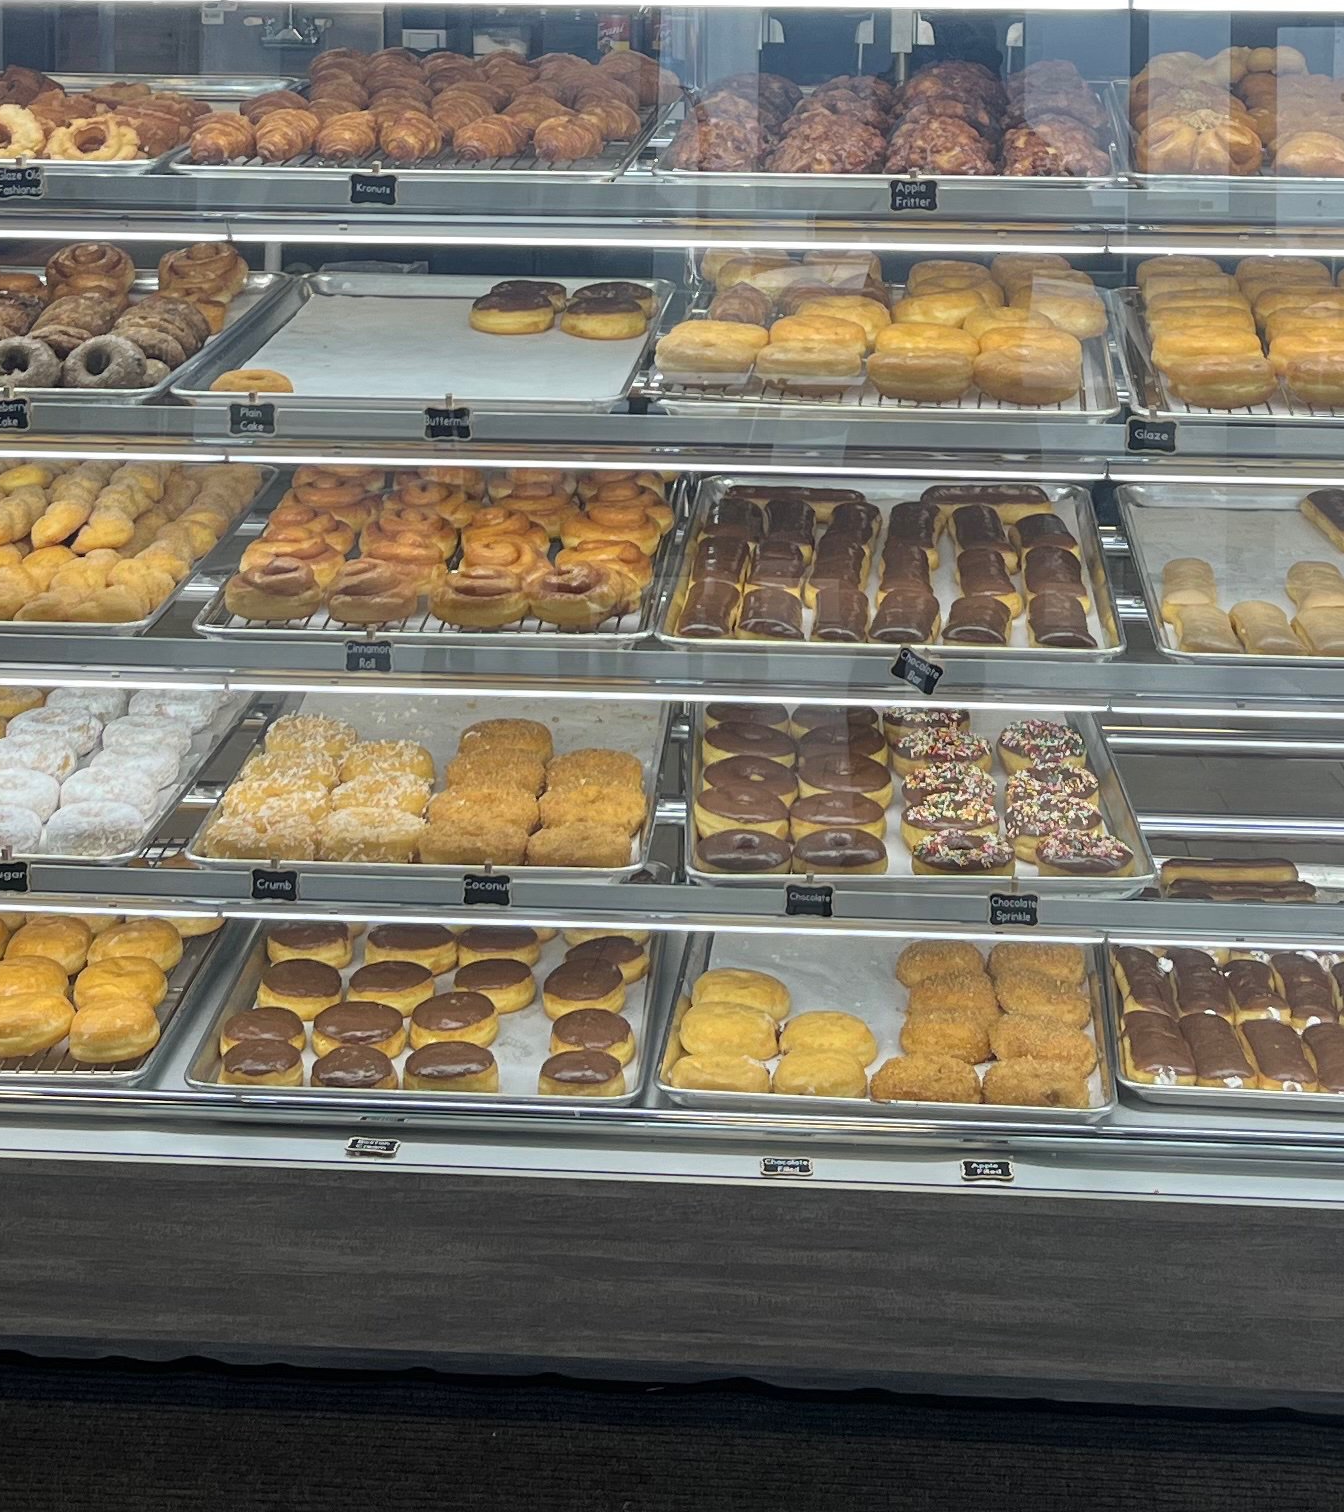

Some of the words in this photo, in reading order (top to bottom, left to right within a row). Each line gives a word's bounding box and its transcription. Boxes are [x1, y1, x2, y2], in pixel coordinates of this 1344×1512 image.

[25, 168, 41, 180] Old
[356, 182, 391, 194] Kronuts
[895, 182, 927, 194] Apple
[895, 196, 932, 208] Fritter
[239, 407, 263, 418] Plain
[239, 420, 265, 431] Cake
[1134, 429, 1169, 441] Glaze
[346, 642, 392, 654] Cinnamon
[358, 657, 377, 669] Roll
[899, 649, 940, 680] Chocolate
[906, 670, 922, 685] Bar
[256, 878, 292, 891] Crumb
[464, 878, 511, 891] Coconut
[789, 891, 831, 902] Chocolate
[991, 896, 1036, 909] Chocolate
[996, 910, 1031, 923] Sprinkle
[765, 1158, 808, 1166] Chocolate
